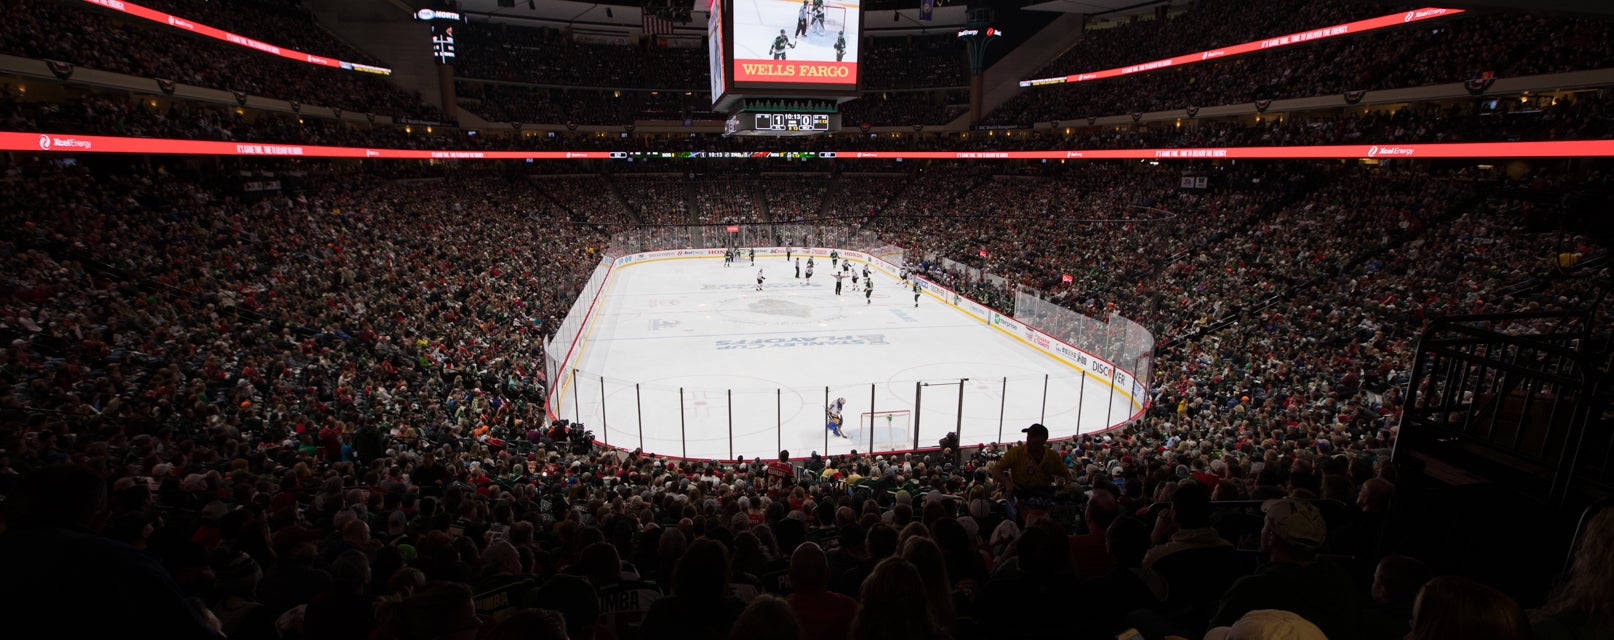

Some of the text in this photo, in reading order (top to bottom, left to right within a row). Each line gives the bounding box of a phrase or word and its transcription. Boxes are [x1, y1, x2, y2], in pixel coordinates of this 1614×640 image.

[435, 10, 460, 20] NORTH
[742, 63, 849, 77] WELLS FARGO
[775, 115, 781, 125] 1
[802, 115, 810, 126] 0
[53, 137, 91, 149] XcelEnergy
[1379, 147, 1414, 155] XcelEnergy
[844, 251, 863, 259] HONDA
[715, 339, 865, 351] STANLEY CUP
[1092, 360, 1126, 386] DISCOVER
[600, 591, 640, 612] UMBA
